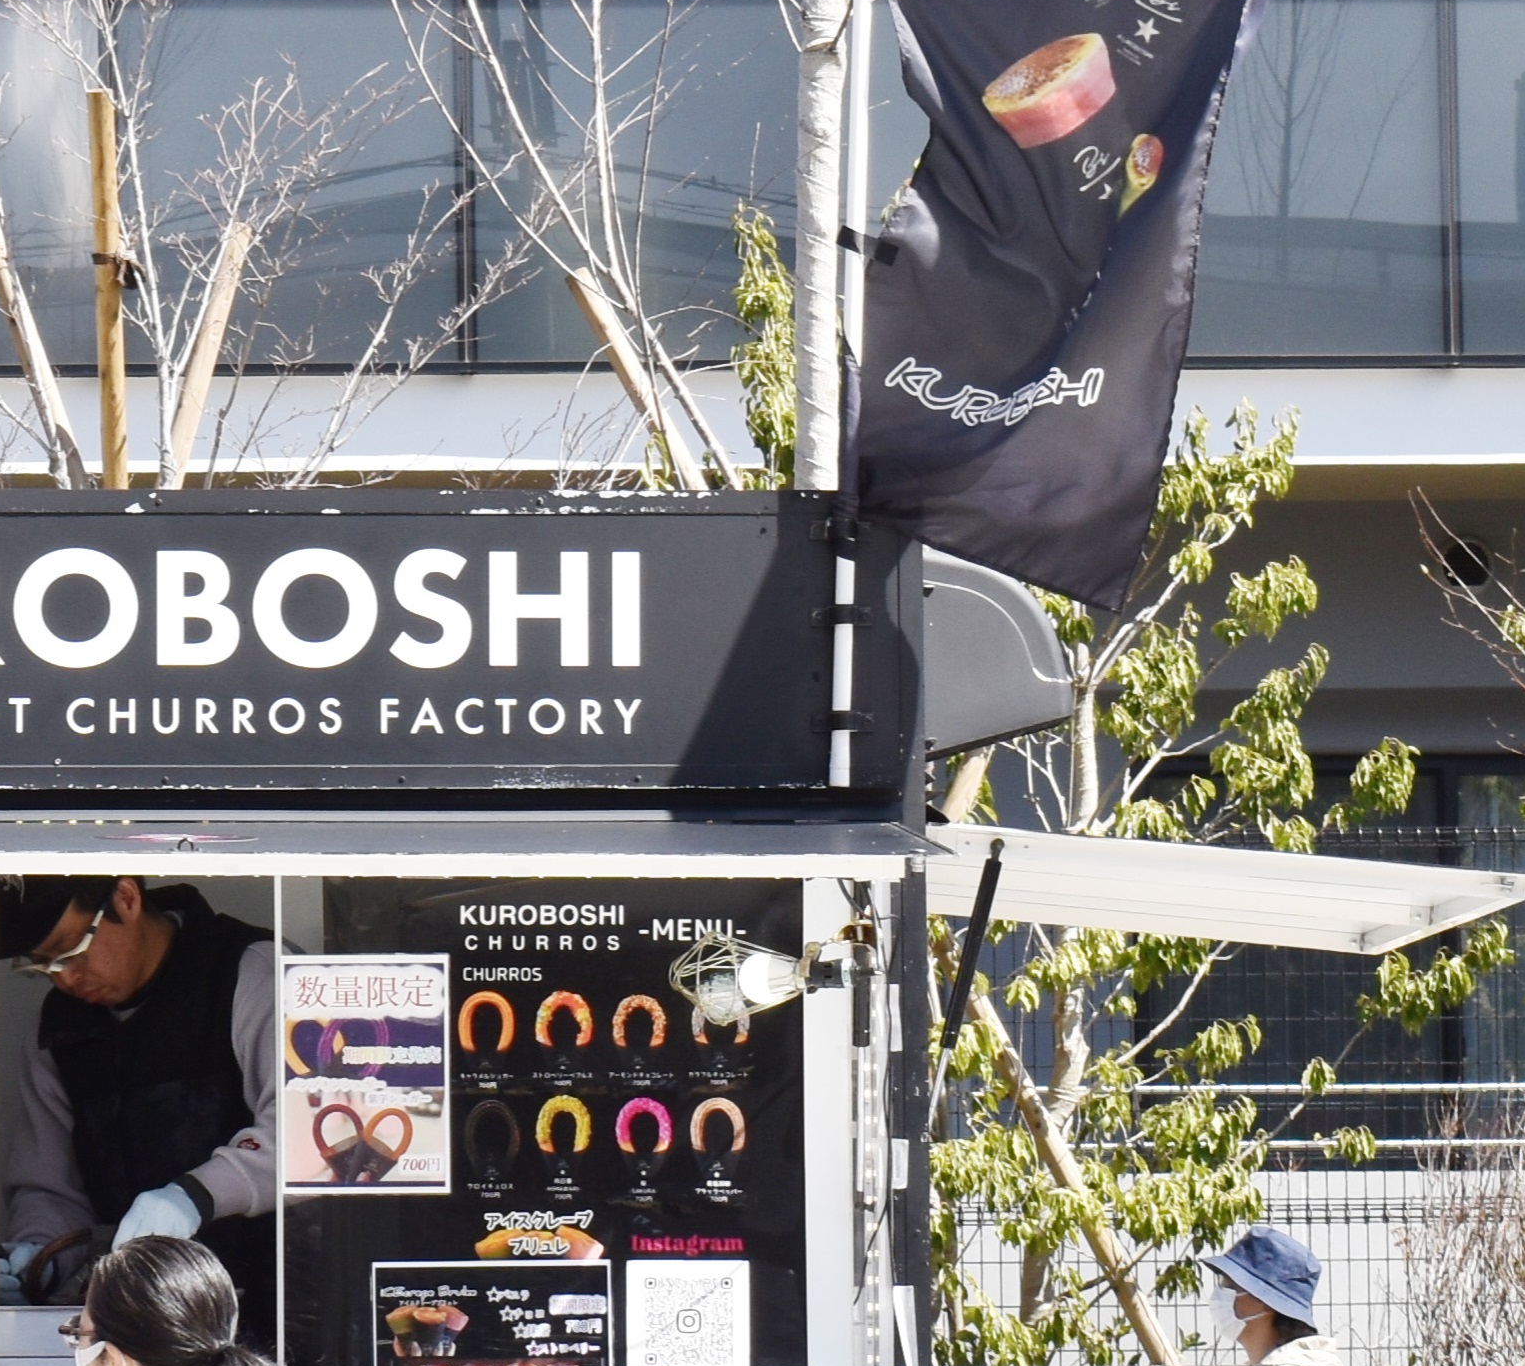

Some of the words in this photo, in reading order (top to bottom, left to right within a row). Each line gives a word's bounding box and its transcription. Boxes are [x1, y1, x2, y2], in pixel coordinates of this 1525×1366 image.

[67, 698, 343, 734] CHURROS
[379, 698, 643, 734] FACTORY
[459, 904, 625, 926] KUROBOSHI
[638, 918, 747, 942] -MENU-
[464, 935, 621, 951] CHURROS
[462, 966, 542, 982] CHURROS
[295, 975, 435, 1008] 数量限定
[403, 1158, 440, 1171] 700円
[631, 1234, 744, 1256] Instagram
